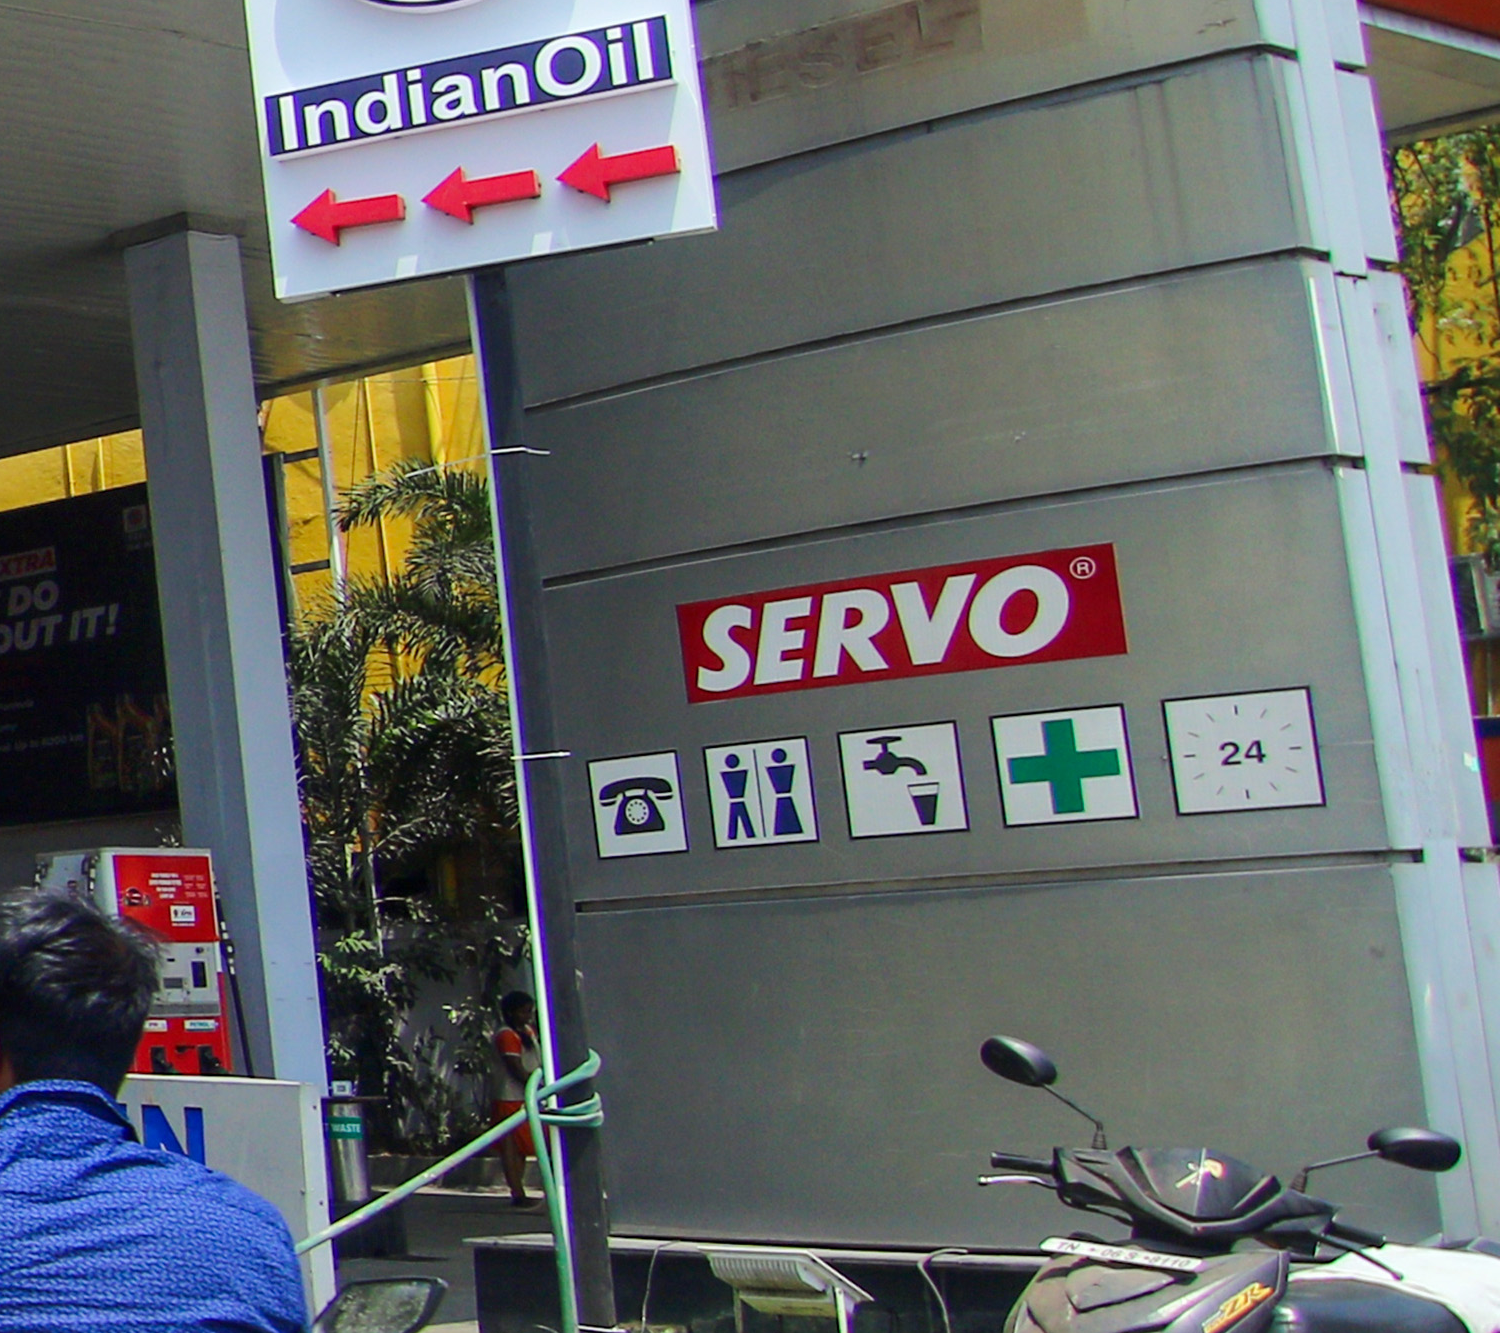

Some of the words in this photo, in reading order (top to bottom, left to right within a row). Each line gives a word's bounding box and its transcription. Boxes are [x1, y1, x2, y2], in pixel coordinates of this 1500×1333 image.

[278, 18, 657, 151] IndianOil
[7, 580, 60, 617] DO
[70, 602, 120, 641] IT!
[696, 564, 1070, 693] SERVO
[1219, 739, 1267, 767] 24
[1057, 1240, 1082, 1252] TN
